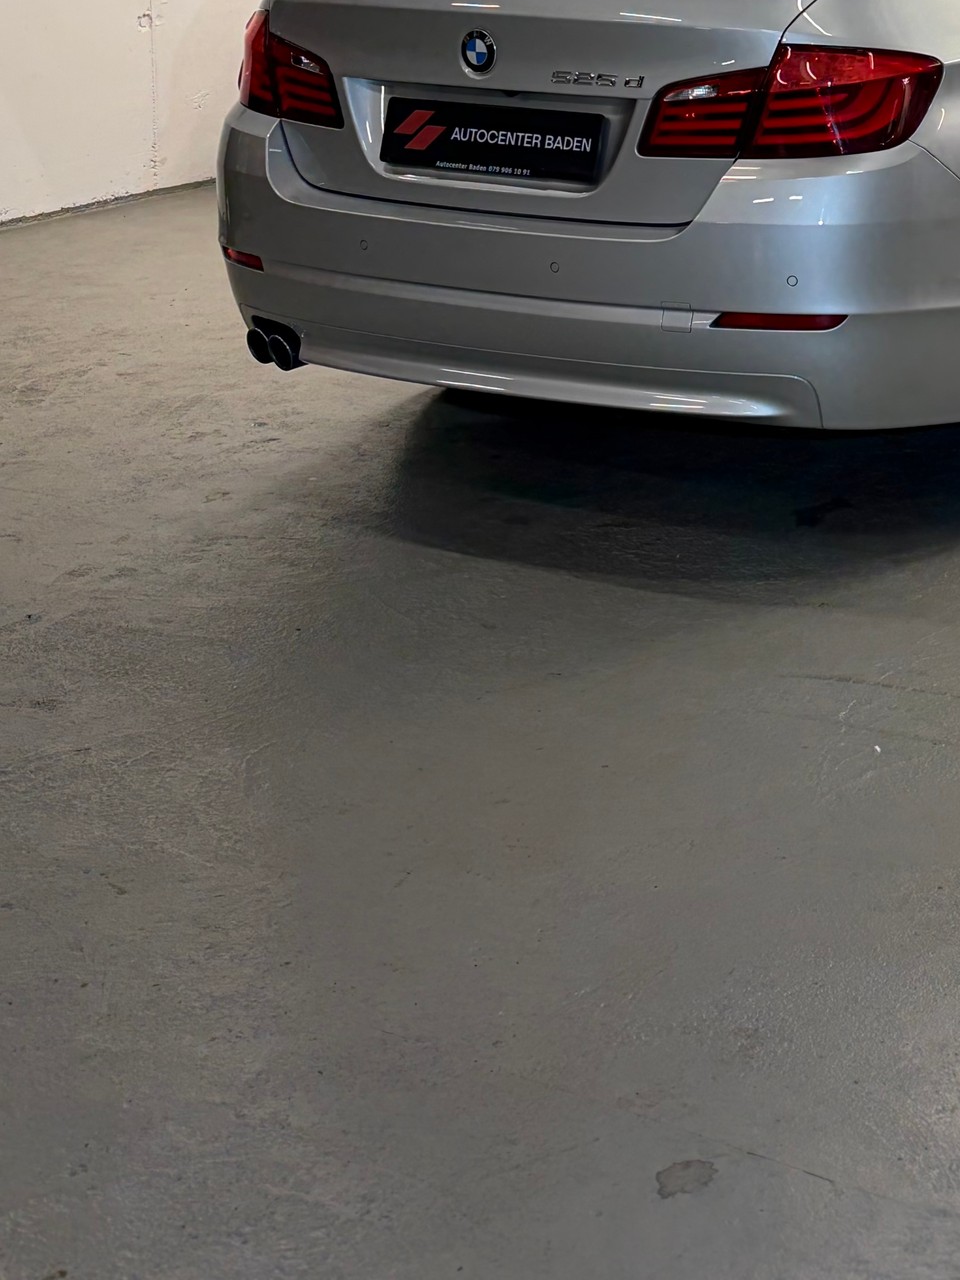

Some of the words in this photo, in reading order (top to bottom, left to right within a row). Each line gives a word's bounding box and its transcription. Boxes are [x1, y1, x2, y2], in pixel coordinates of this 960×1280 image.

[450, 127, 542, 148] AUTOCENTER
[544, 135, 592, 153] BADEN
[435, 161, 467, 169] Autocenter
